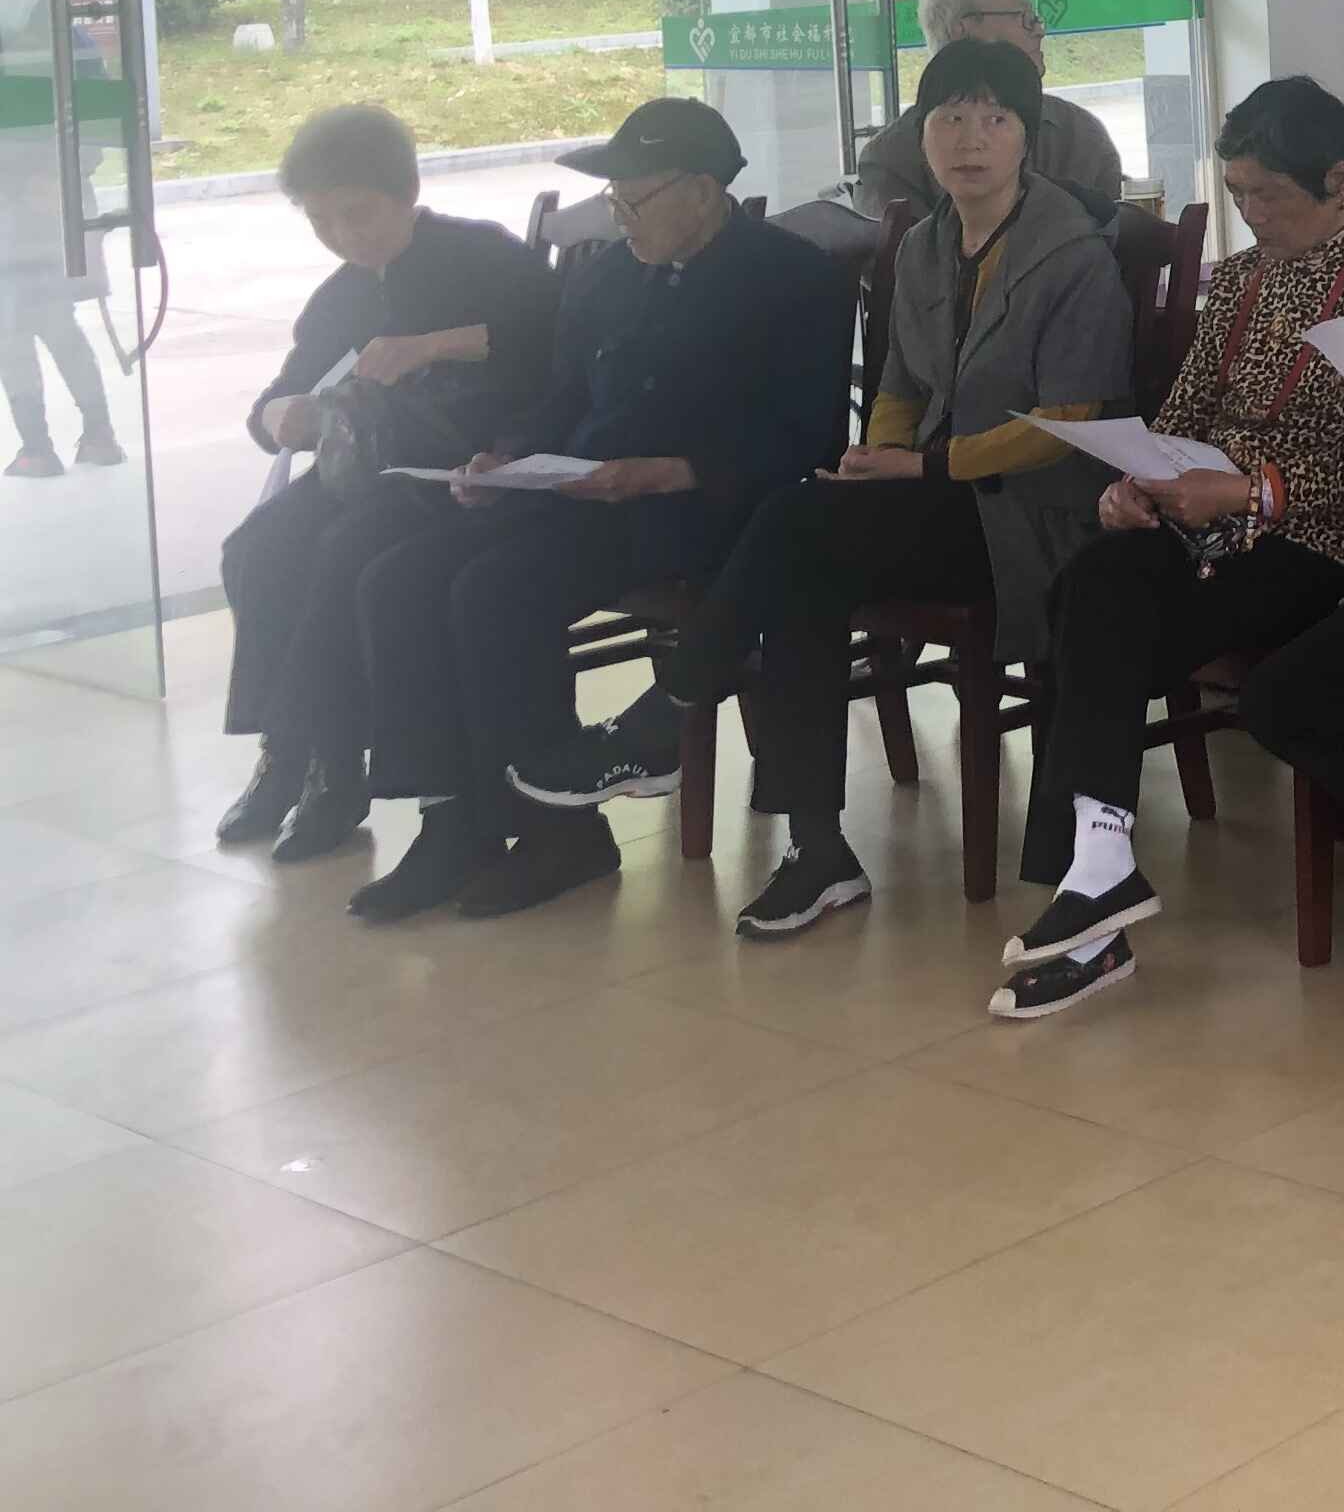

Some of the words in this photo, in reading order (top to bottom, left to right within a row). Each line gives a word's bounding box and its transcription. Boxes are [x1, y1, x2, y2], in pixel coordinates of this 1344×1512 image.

[728, 21, 856, 45] 宜都市社会福利
